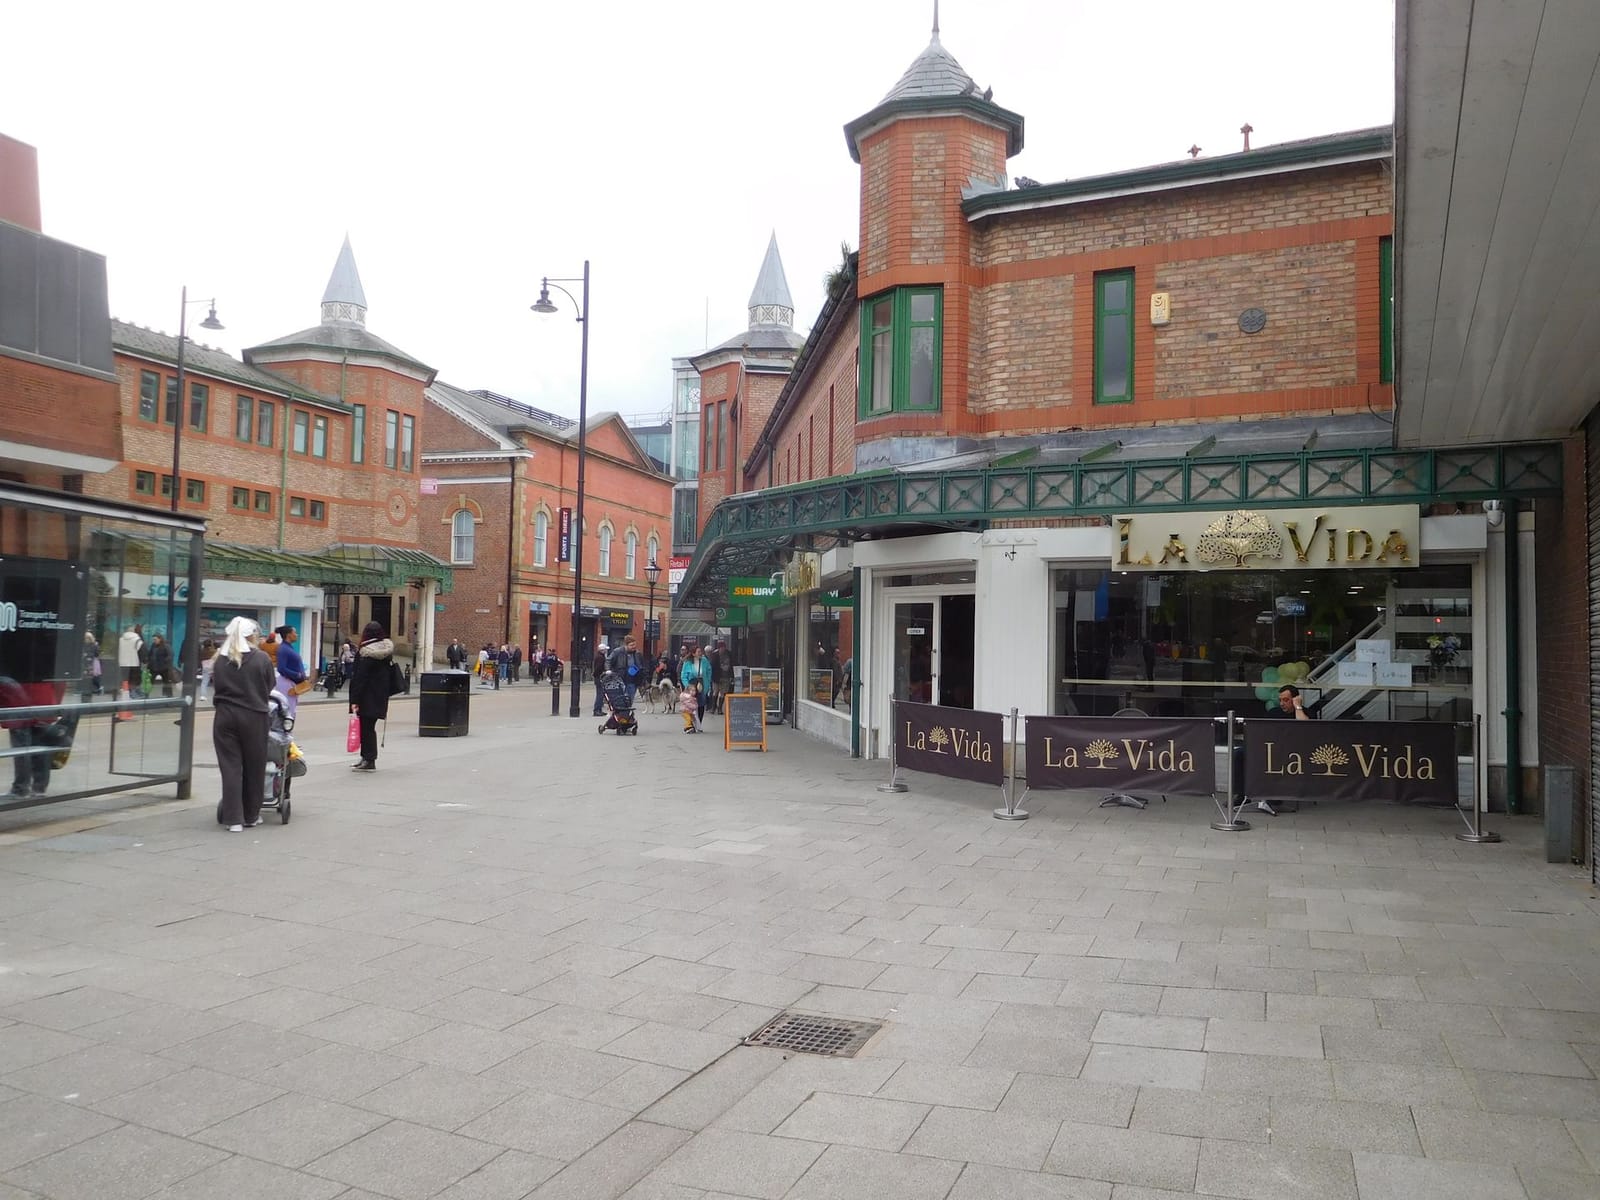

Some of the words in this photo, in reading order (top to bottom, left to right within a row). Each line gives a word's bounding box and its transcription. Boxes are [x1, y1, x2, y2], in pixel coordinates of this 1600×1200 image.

[669, 559, 684, 568] Retail
[733, 587, 776, 596] SUBWAY
[18, 609, 48, 619] Transport
[49, 611, 58, 619] for
[18, 620, 41, 628] Greater
[42, 621, 75, 630] Manchester
[906, 721, 926, 750] La
[950, 727, 992, 763] Vida
[1044, 737, 1079, 768] La
[1121, 739, 1195, 772] Vida
[1264, 742, 1304, 775] La
[1352, 744, 1436, 780] Vida
